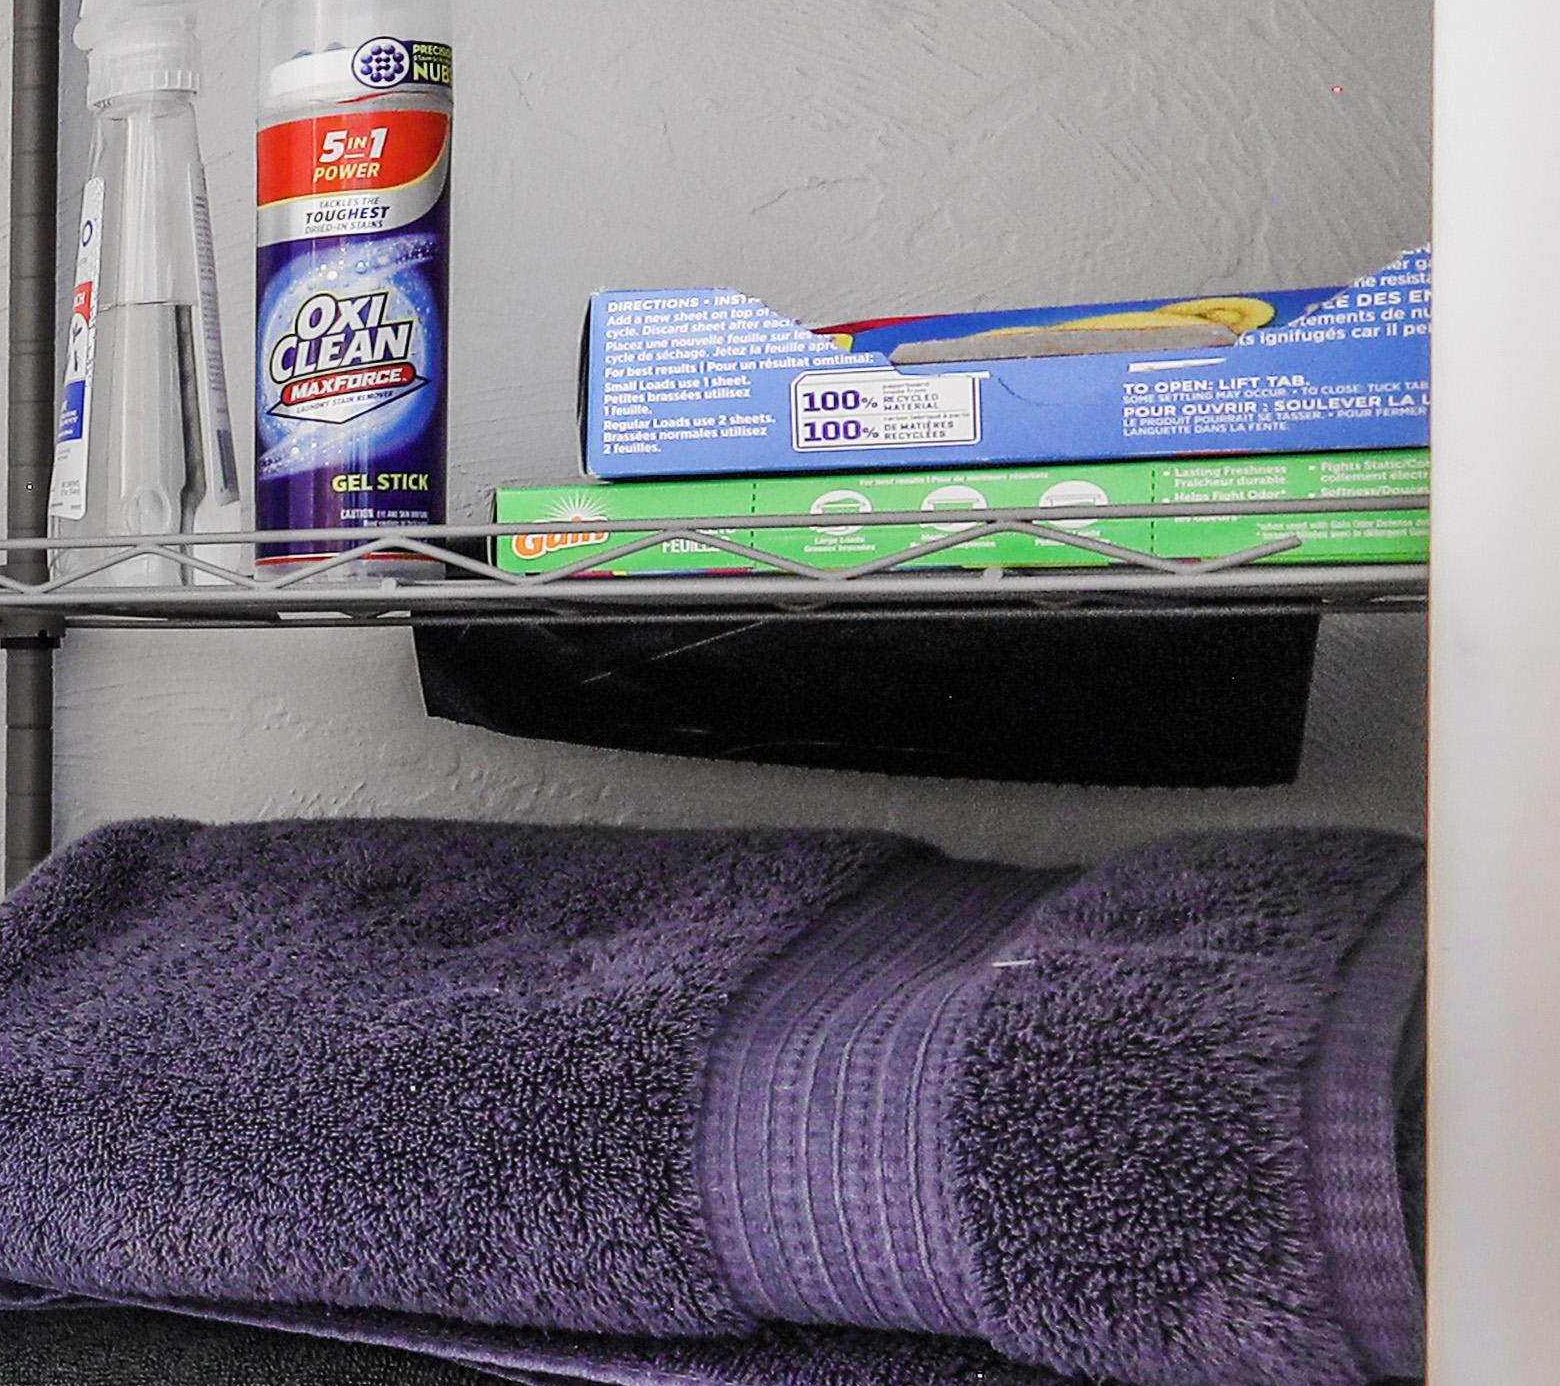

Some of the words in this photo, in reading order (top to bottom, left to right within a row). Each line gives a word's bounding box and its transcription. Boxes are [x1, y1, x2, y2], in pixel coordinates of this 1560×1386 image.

[313, 163, 380, 182] POWER
[362, 197, 380, 205] THE
[306, 206, 390, 224] TOUGHEST
[608, 298, 699, 312] DIRECTIONS
[295, 292, 388, 341] OXI
[608, 315, 630, 326] Add
[645, 313, 669, 323] new
[674, 310, 707, 322] sheet
[731, 309, 752, 320] top
[643, 323, 688, 336] Discard
[692, 320, 725, 332] sheet
[1351, 326, 1379, 339] car
[646, 340, 667, 349] une
[671, 336, 717, 348] nouvelle
[721, 333, 766, 344] feuille
[270, 321, 413, 384] CLEAN
[638, 350, 653, 362] de
[713, 344, 745, 358] Jetez
[765, 341, 805, 353] feuille
[605, 367, 625, 378] For
[627, 366, 653, 376] best
[655, 364, 697, 375] results
[707, 362, 737, 371] Pour
[740, 363, 756, 371] un
[290, 368, 403, 401] MAXFORCE
[604, 382, 637, 392] Small
[640, 380, 676, 391] Loads
[679, 379, 700, 388] use
[712, 376, 751, 386] sheet.
[1123, 383, 1149, 395] TO
[1154, 380, 1214, 393] OPEN:
[1219, 378, 1262, 390] LIFT
[1267, 376, 1310, 388] TAB.
[297, 400, 330, 413] LAUNDRY
[333, 396, 353, 406] STAIN
[357, 391, 393, 402] REMOVER
[604, 393, 645, 404] Petites
[704, 388, 751, 399] utilisez
[803, 390, 877, 412] 100%
[883, 394, 938, 403] RECYCLED
[611, 405, 653, 416] feuille.
[884, 402, 938, 411] MATERIAL
[1123, 404, 1177, 418] POUR
[1182, 402, 1257, 415] OUVRIR
[1274, 397, 1382, 412] SOULEVER
[1388, 395, 1416, 407] LA
[604, 419, 650, 432] Regular
[653, 417, 691, 428] Loads
[693, 417, 715, 426] use
[730, 414, 776, 424] sheets.
[803, 420, 879, 442] 100%
[603, 431, 657, 442] Brassées
[659, 428, 718, 440] normales
[721, 426, 767, 438] utilisez
[613, 442, 661, 454] feuilles.
[1224, 465, 1287, 476] Freshness
[332, 474, 373, 492] GEL
[377, 473, 428, 490] STICK
